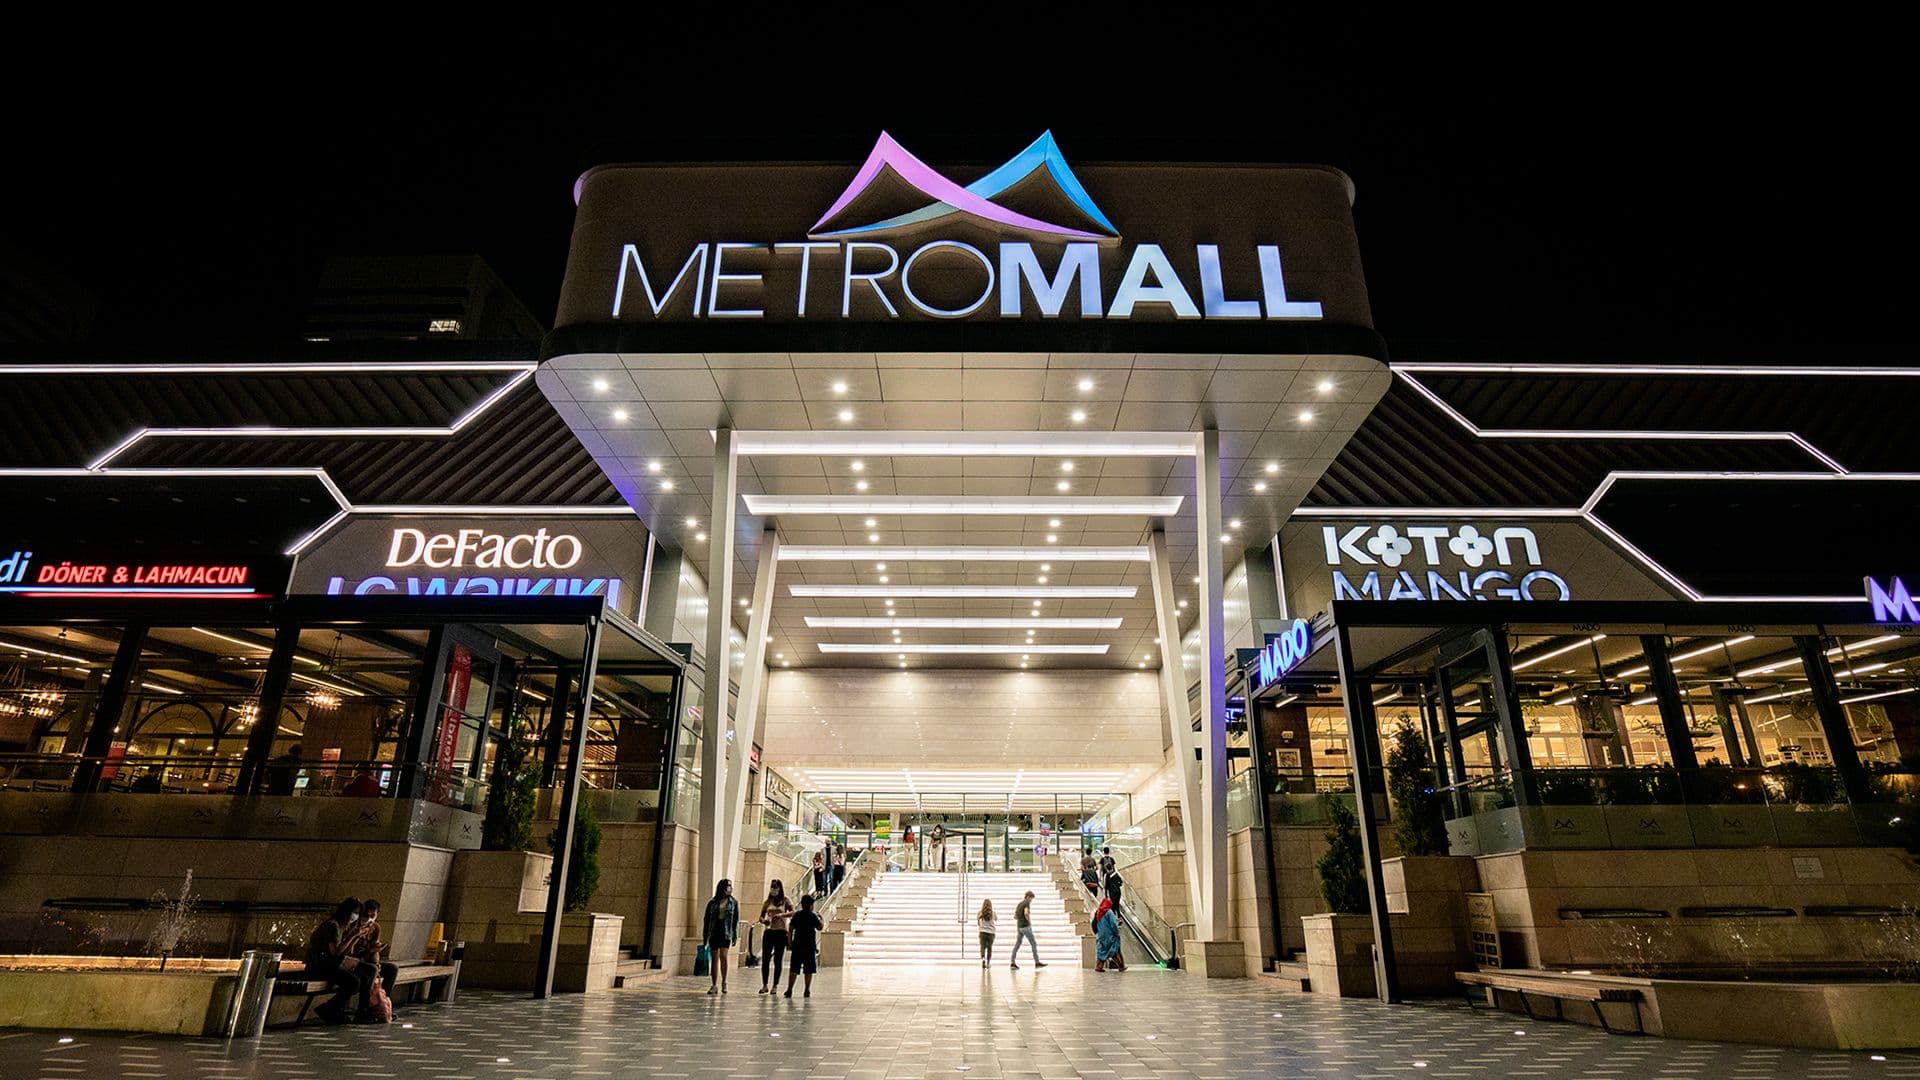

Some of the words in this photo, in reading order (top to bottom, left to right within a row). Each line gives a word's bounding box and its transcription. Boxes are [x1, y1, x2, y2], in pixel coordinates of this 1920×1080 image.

[612, 240, 1323, 319] METROMALL
[385, 528, 582, 569] DeFacto
[38, 562, 107, 583] DÖNER
[112, 567, 129, 583] &
[134, 567, 247, 584] LAHMACUN
[1332, 570, 1570, 601] MANGO
[1259, 618, 1309, 688] MADO
